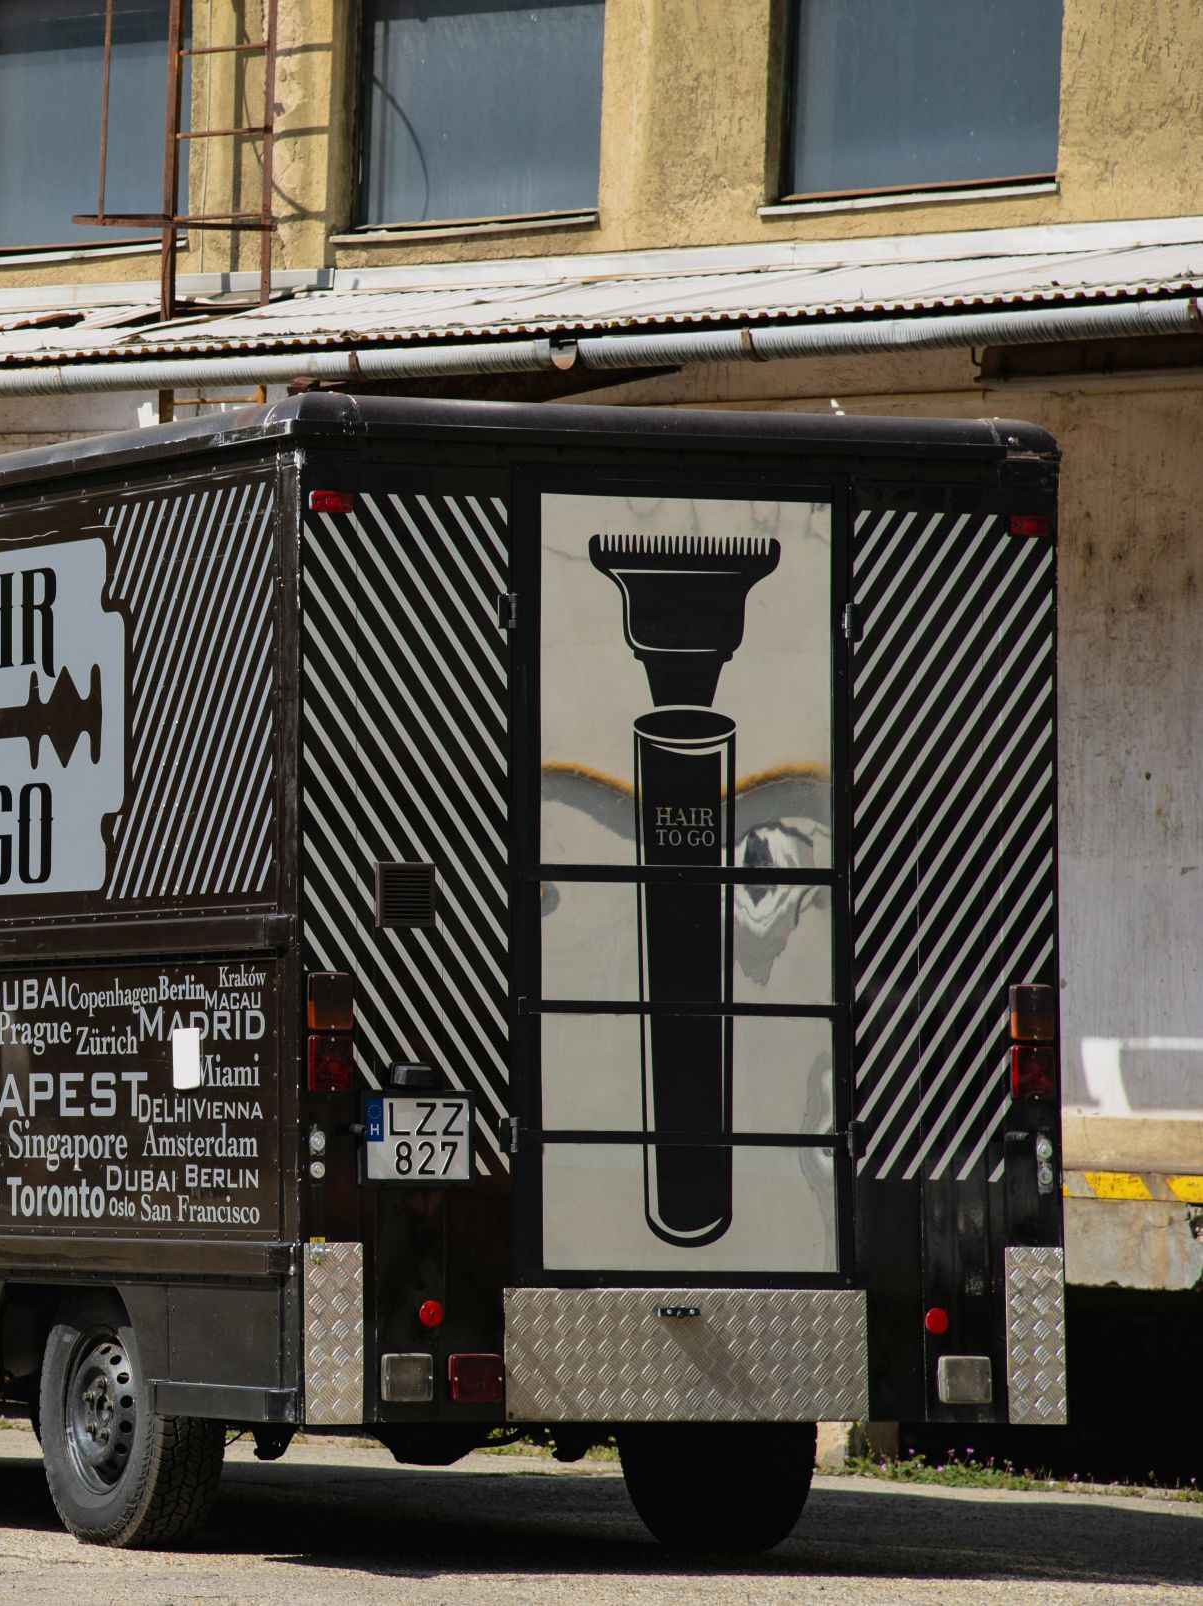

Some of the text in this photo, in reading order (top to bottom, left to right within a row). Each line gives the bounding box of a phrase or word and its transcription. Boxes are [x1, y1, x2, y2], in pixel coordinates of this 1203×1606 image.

[656, 807, 714, 827] HAIR
[656, 829, 715, 847] TO GO
[158, 975, 206, 1001] Berlin
[218, 964, 266, 988] Kraków
[68, 978, 158, 1017] Copenhagen
[205, 990, 261, 1011] MACAU
[76, 1025, 138, 1056] Zürich
[138, 1094, 191, 1123] DELHI
[193, 1098, 264, 1120] VIENNA
[389, 1102, 464, 1137] LZZ
[142, 1123, 259, 1158] Amsterdam
[370, 1123, 380, 1136] H
[8, 1119, 128, 1172] Singapore
[395, 1140, 458, 1176] 827
[106, 1165, 176, 1193] DUBAI
[185, 1163, 259, 1189] BERLIN
[6, 1176, 105, 1218] Toronto
[109, 1196, 136, 1217] Oslo
[140, 1194, 260, 1225] San Francisco
